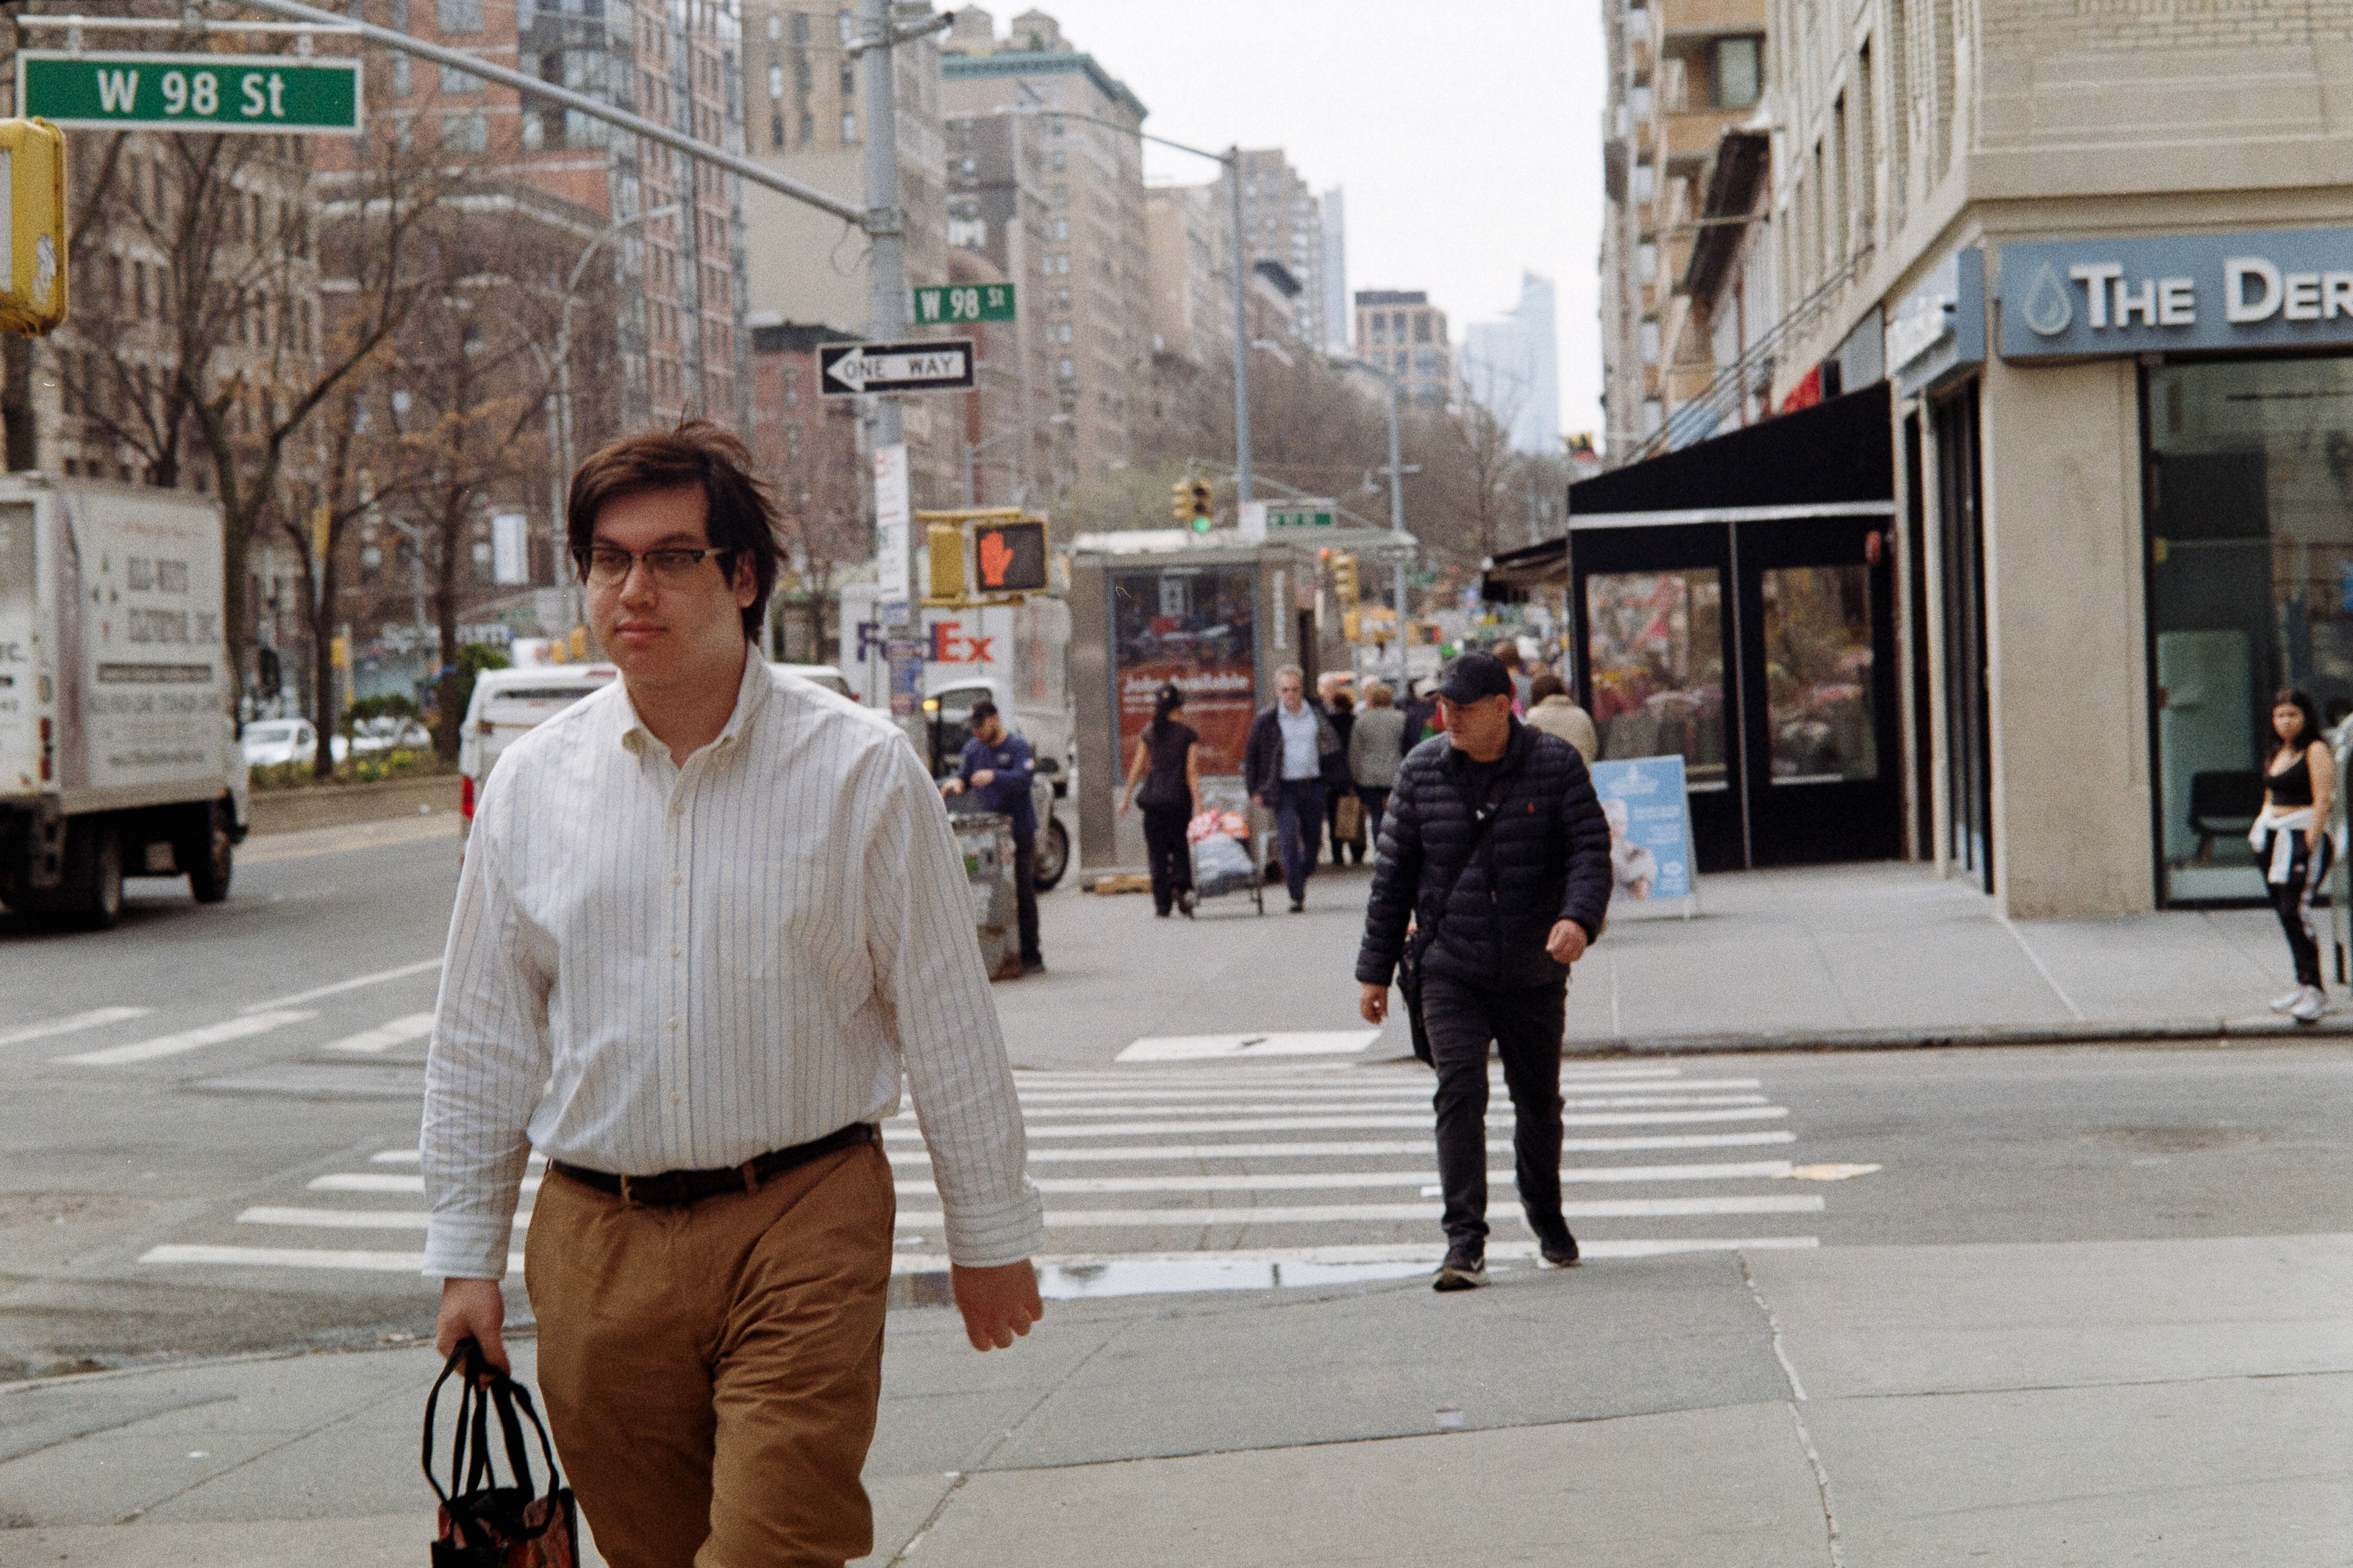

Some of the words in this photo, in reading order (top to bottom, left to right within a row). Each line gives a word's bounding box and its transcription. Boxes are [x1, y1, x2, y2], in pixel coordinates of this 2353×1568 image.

[98, 69, 139, 112] W
[161, 71, 218, 115] 98
[240, 73, 285, 117] St
[921, 290, 940, 321] W
[950, 287, 979, 319] 98
[2069, 261, 2196, 329] THE
[846, 357, 883, 380] ONE
[907, 355, 954, 377] WAY
[857, 622, 995, 664] FdEx
